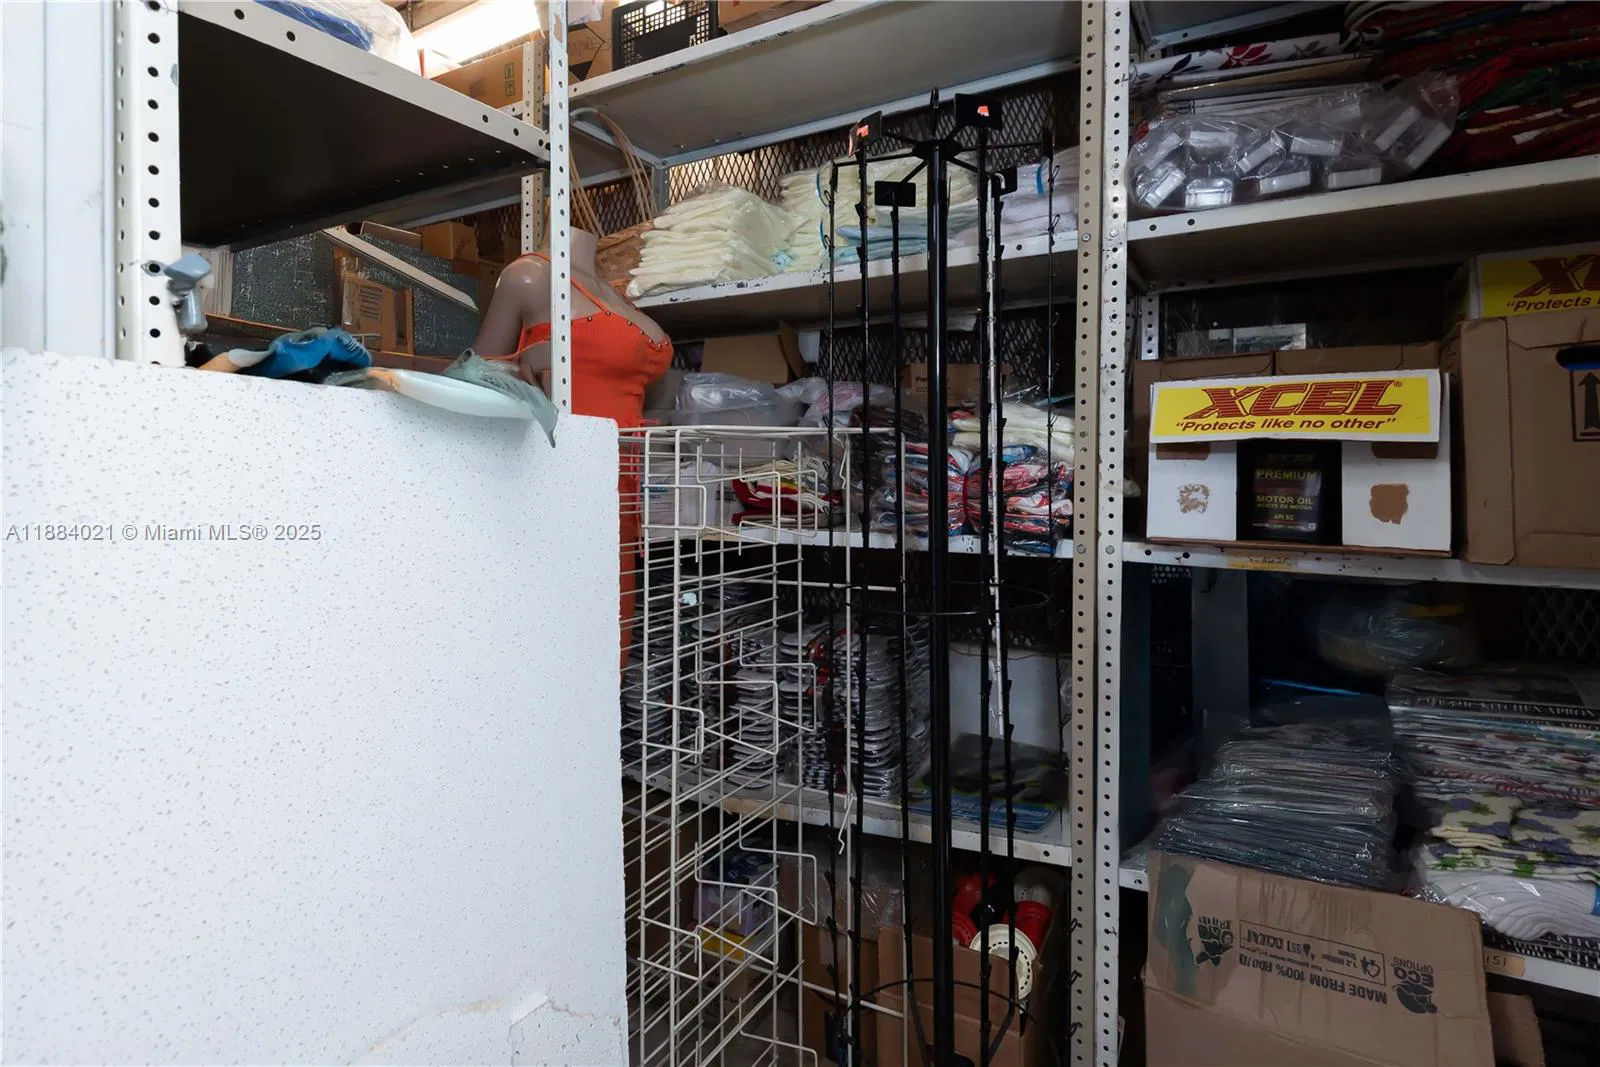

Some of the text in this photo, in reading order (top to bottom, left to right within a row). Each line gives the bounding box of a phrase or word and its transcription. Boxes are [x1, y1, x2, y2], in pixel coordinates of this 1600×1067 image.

[1260, 418, 1294, 429] like
[1299, 419, 1324, 429] no
[1256, 469, 1317, 481] PREMIUM
[1256, 495, 1314, 505] MOTOR OIL
[1276, 963, 1306, 982] 100%
[1391, 956, 1434, 974] OPTIONS
[1310, 972, 1345, 993] FROM
[1394, 966, 1434, 988] ECO
[1350, 983, 1387, 1004] MADE
